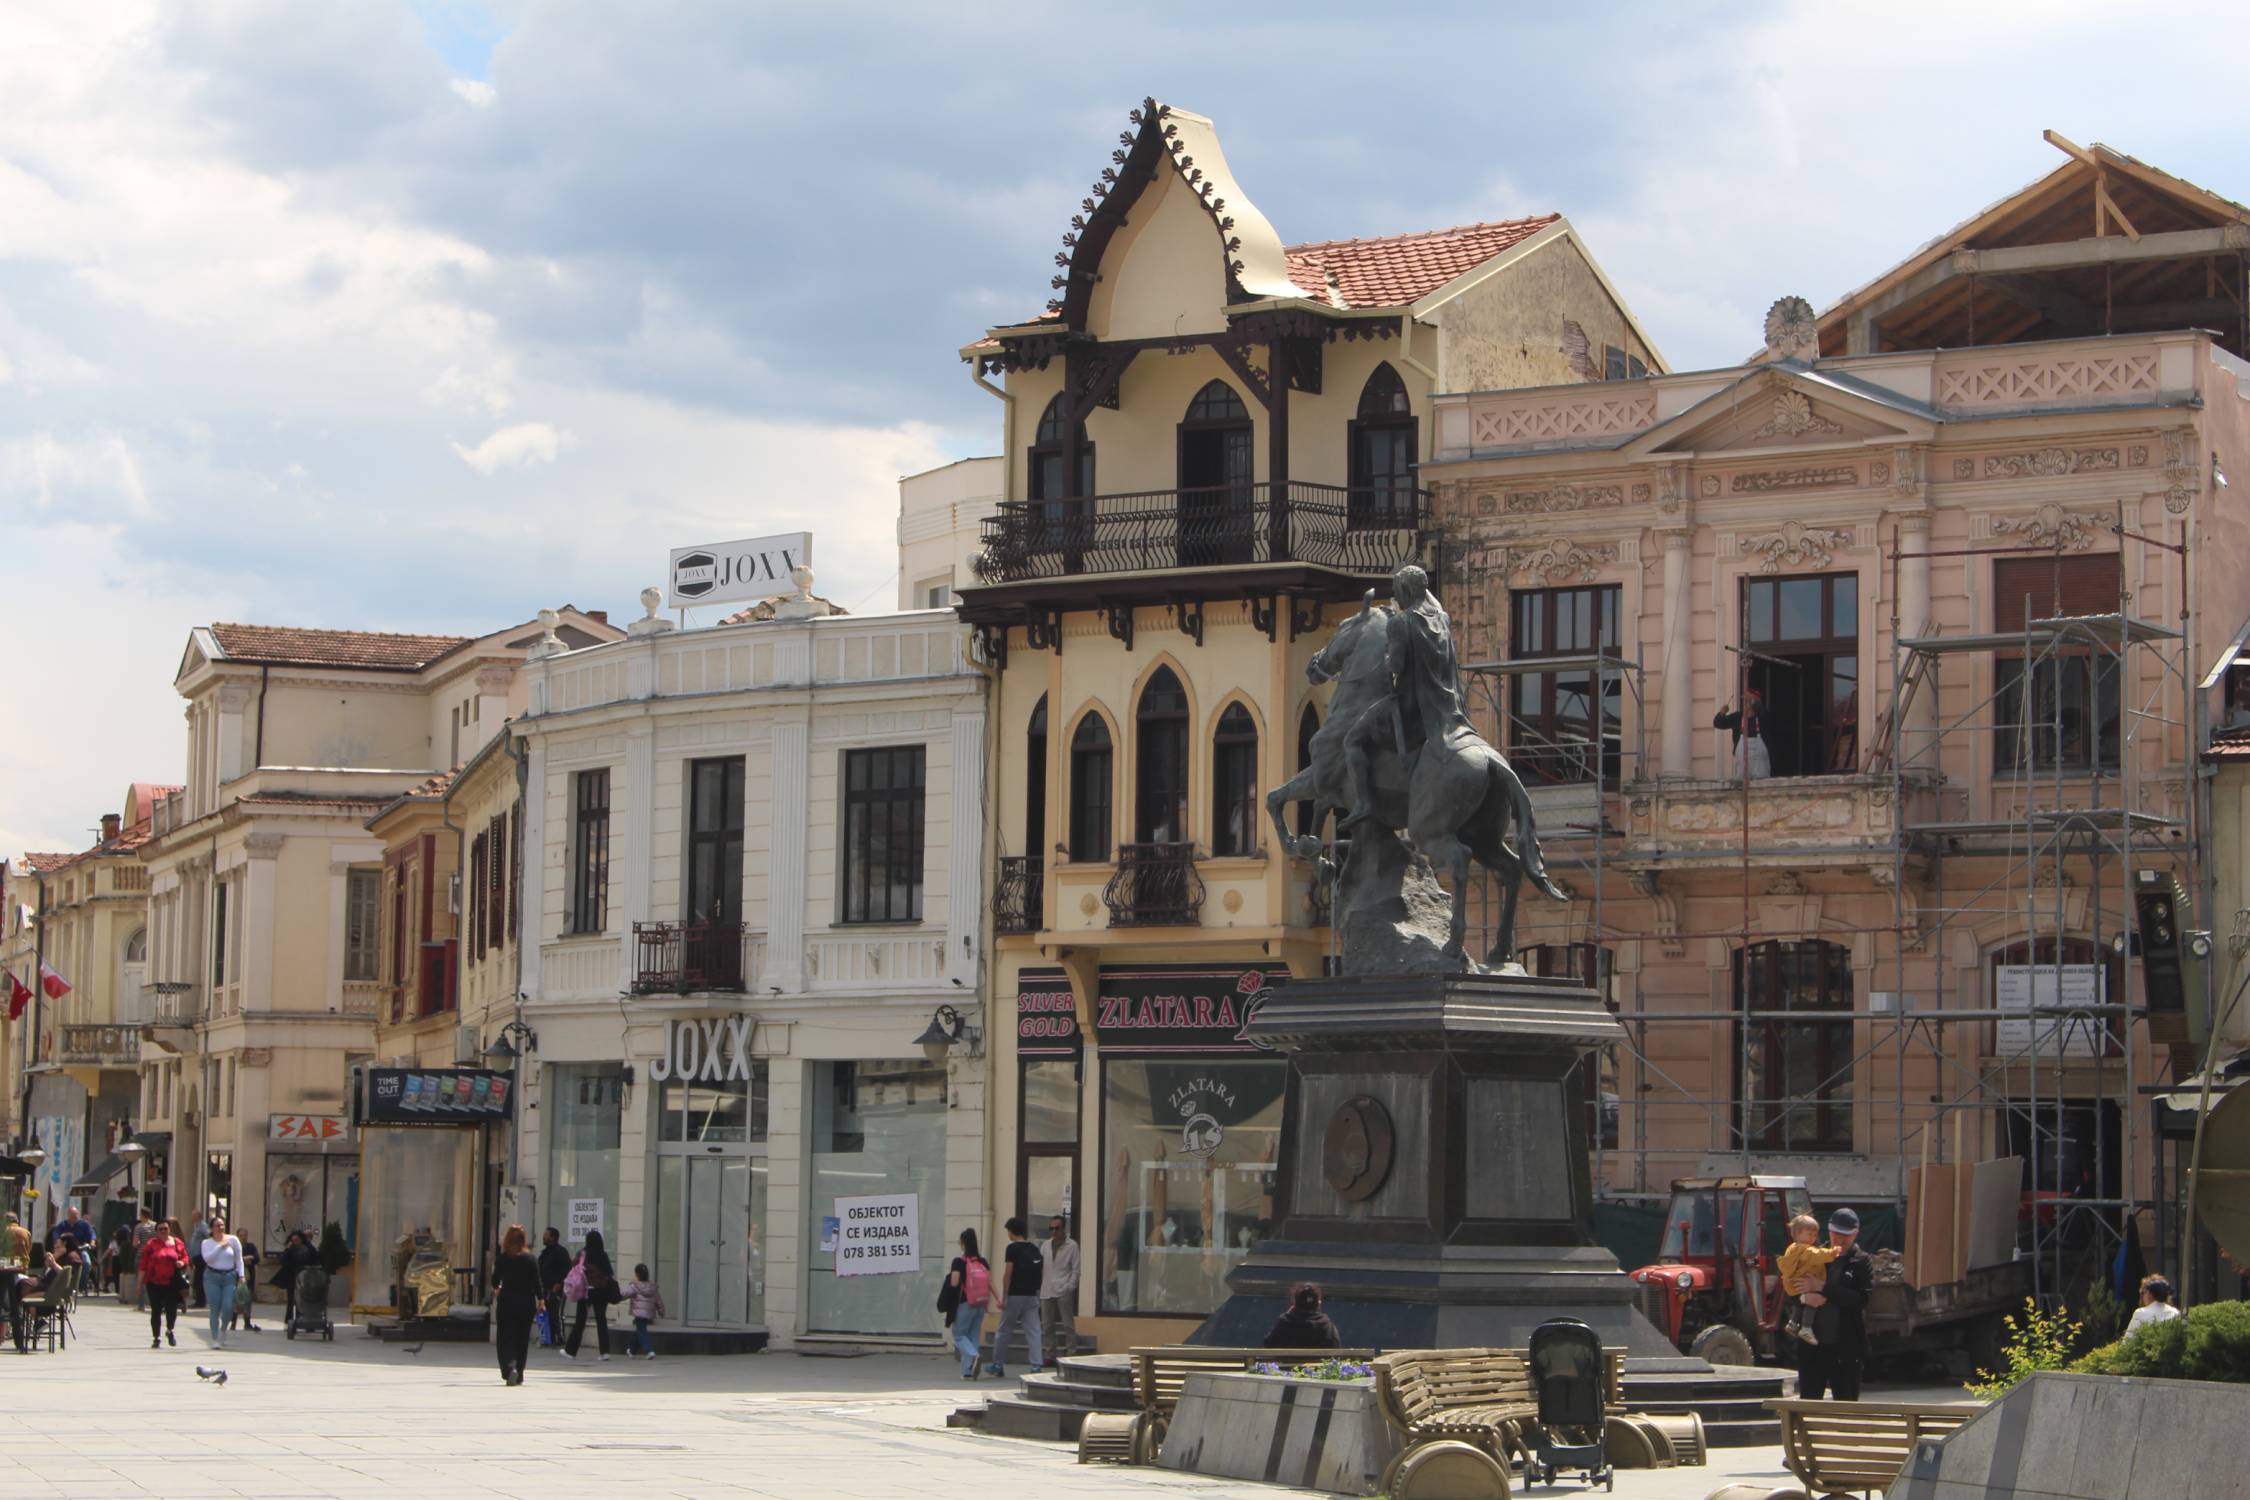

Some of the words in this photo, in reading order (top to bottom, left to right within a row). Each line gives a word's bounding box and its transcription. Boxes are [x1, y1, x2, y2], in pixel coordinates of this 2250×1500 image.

[720, 549, 797, 587] JOXX
[1017, 993, 1073, 1012] SILVER
[1098, 996, 1239, 1028] ZLATARA
[1019, 1017, 1074, 1037] GOLD
[650, 1016, 754, 1081] JOXX
[377, 1077, 399, 1085] TIME
[377, 1085, 400, 1095] OUT
[1169, 1078, 1236, 1109] ZLATARA
[848, 1205, 905, 1219] ОБЈЕКТОТ
[847, 1227, 860, 1239] СЕ
[863, 1226, 909, 1240] ИЗДАВА
[843, 1247, 864, 1259] 078
[867, 1246, 887, 1257] 381
[891, 1245, 911, 1256] 551
